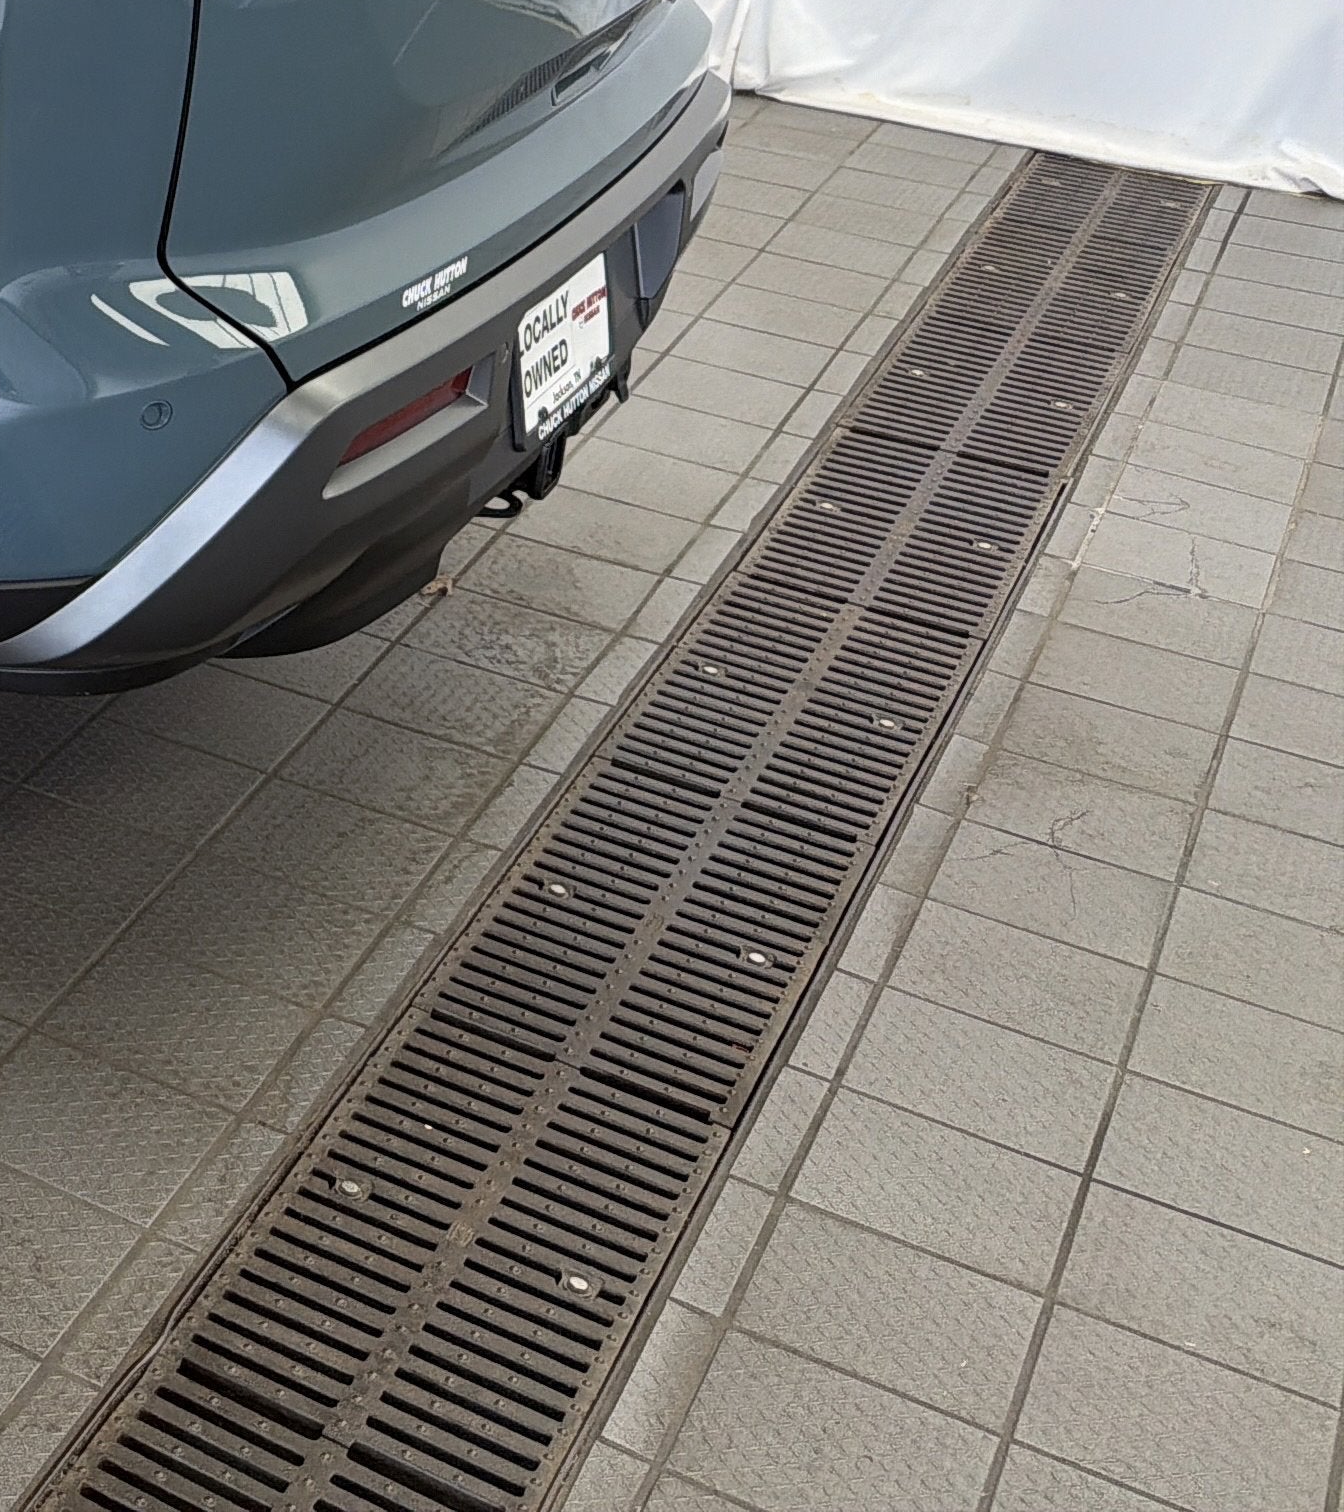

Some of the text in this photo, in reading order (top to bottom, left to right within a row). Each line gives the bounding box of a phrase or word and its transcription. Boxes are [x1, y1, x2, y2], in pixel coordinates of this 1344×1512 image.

[402, 256, 468, 307] CHUCK HUTTON
[417, 284, 451, 311] NISSAN
[523, 337, 569, 399] OWNED
[538, 362, 611, 442] CHUCK HUTTON NISSAN
